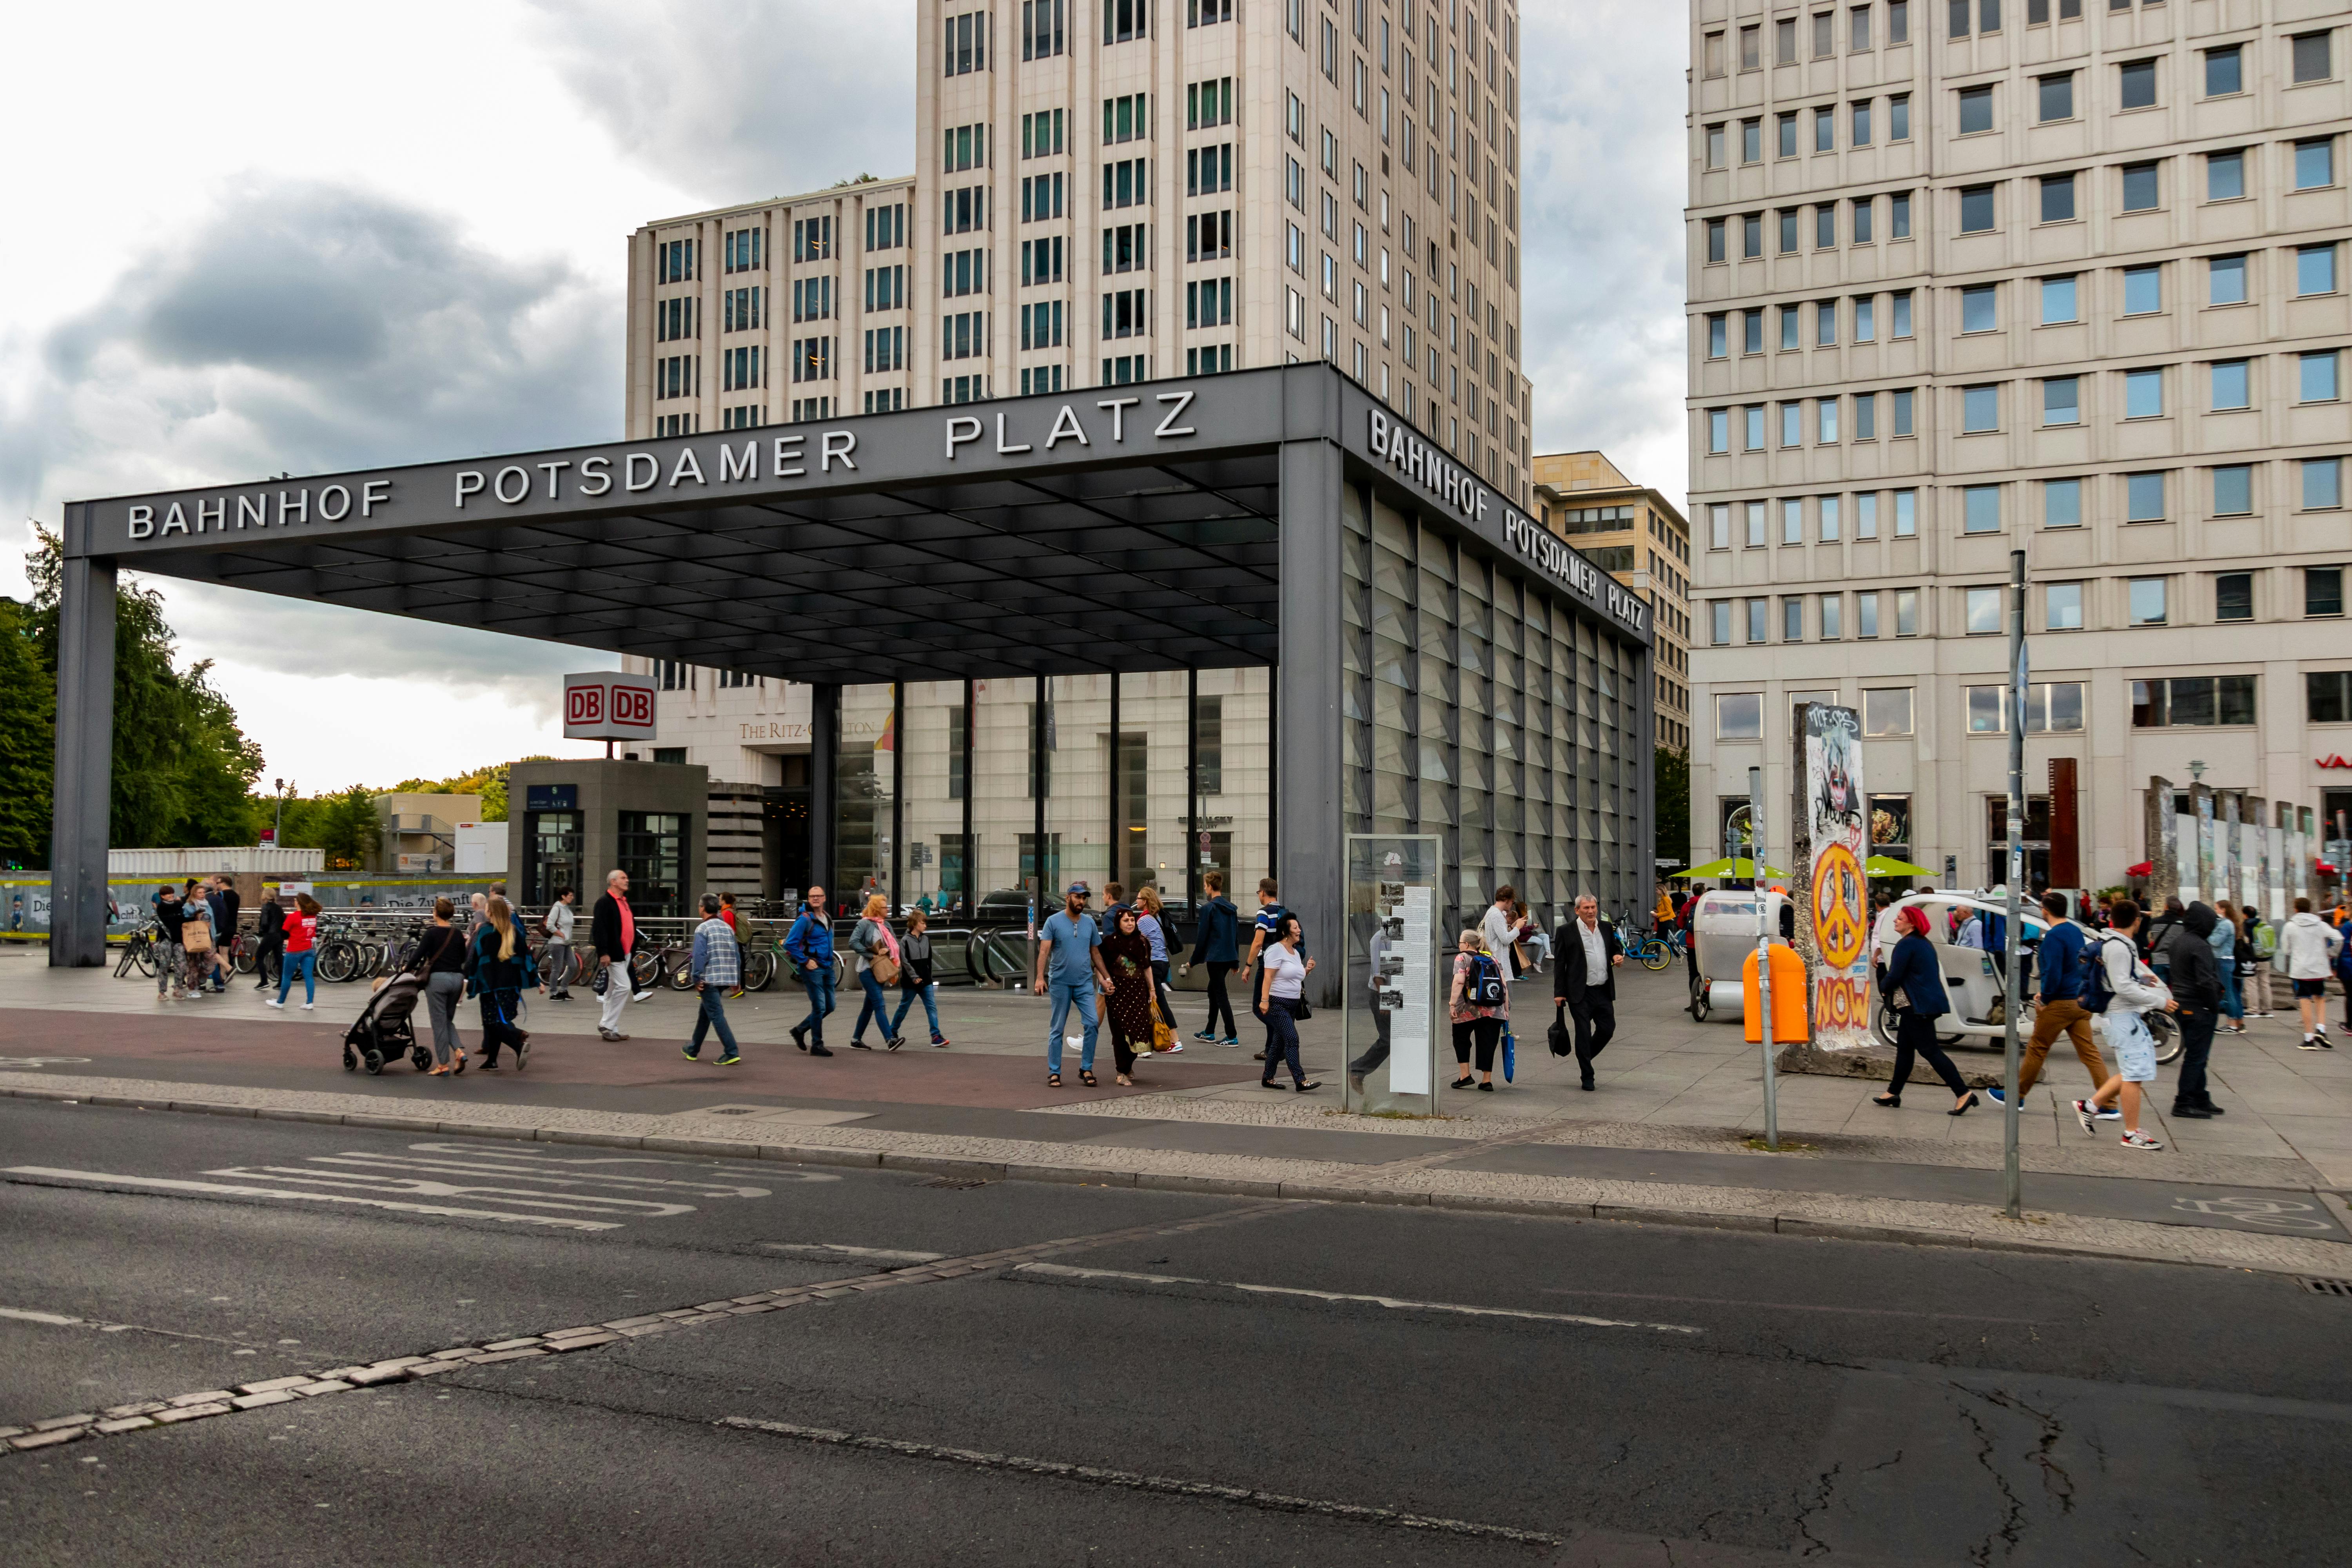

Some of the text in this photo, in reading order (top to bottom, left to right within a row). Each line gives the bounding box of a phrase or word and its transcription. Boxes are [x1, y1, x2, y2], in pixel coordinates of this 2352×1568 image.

[129, 391, 1197, 539] BAHNHOF POTSDAMER PLATZ
[1368, 409, 1643, 630] BAHNHOF POTSDAMER PLATZ
[571, 691, 600, 719] DB
[616, 691, 648, 720] DB
[739, 723, 766, 739] THE
[418, 893, 470, 907] Zunft
[1815, 976, 1871, 1032] NOW
